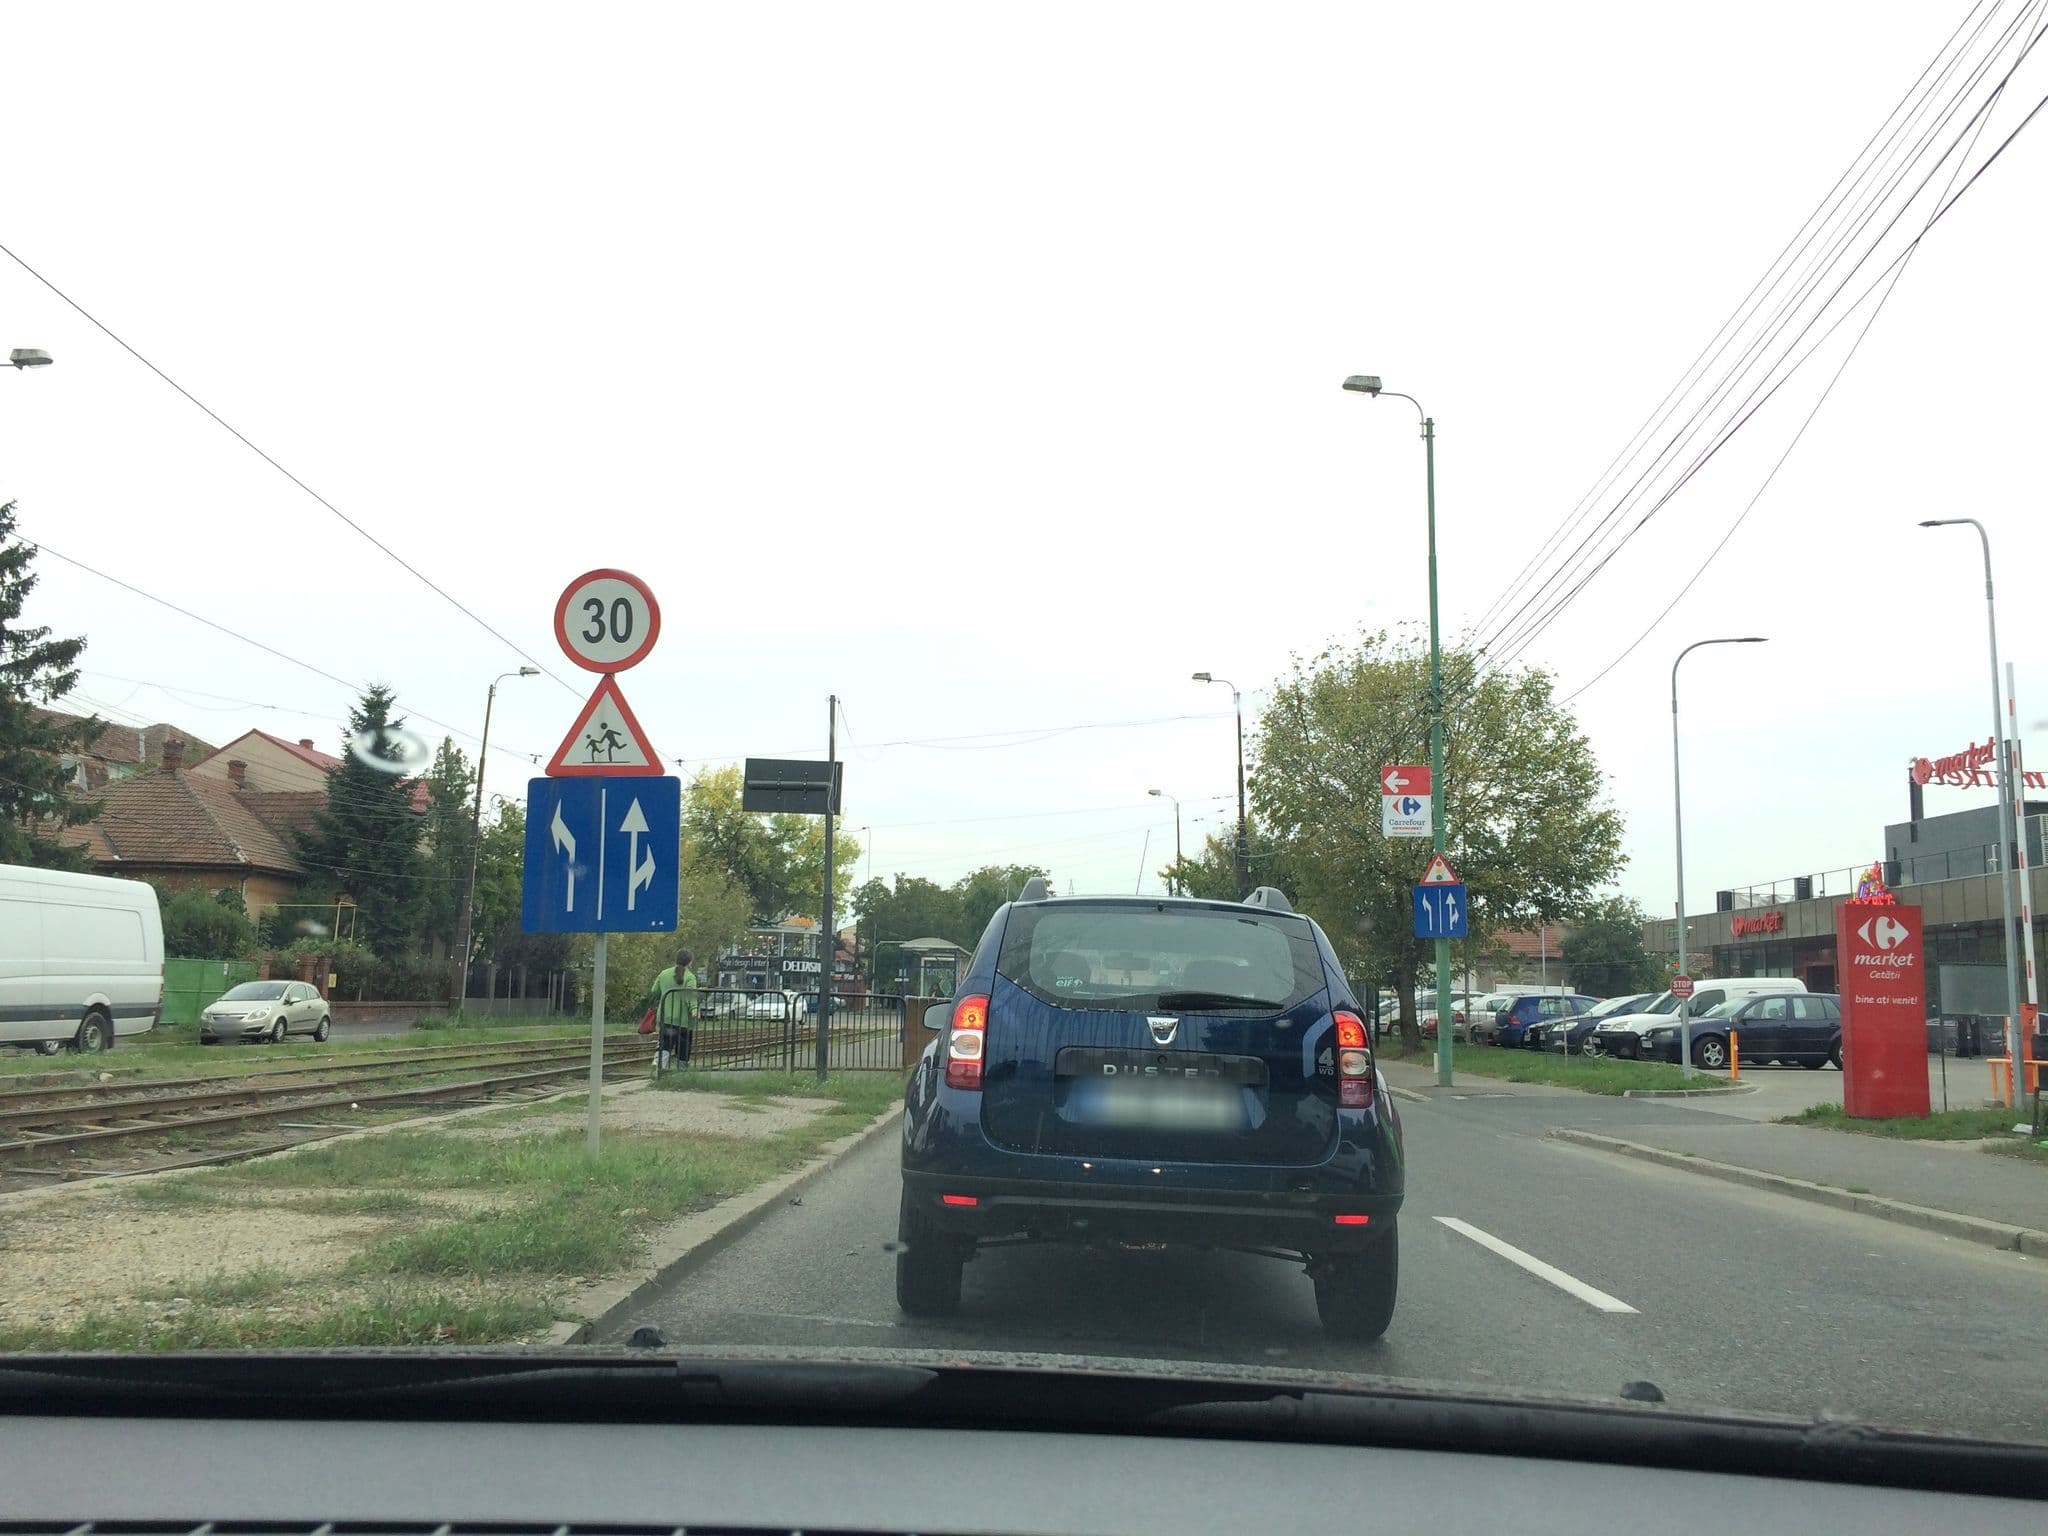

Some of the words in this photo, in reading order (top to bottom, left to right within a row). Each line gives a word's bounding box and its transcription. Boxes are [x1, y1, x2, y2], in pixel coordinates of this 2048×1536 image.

[582, 597, 633, 644] 30
[1934, 736, 1996, 778] market
[1388, 818, 1426, 826] Carrefour
[1743, 910, 1783, 933] market
[1854, 952, 1915, 968] market
[1672, 980, 1693, 989] STOP
[1855, 994, 1875, 1004] bine
